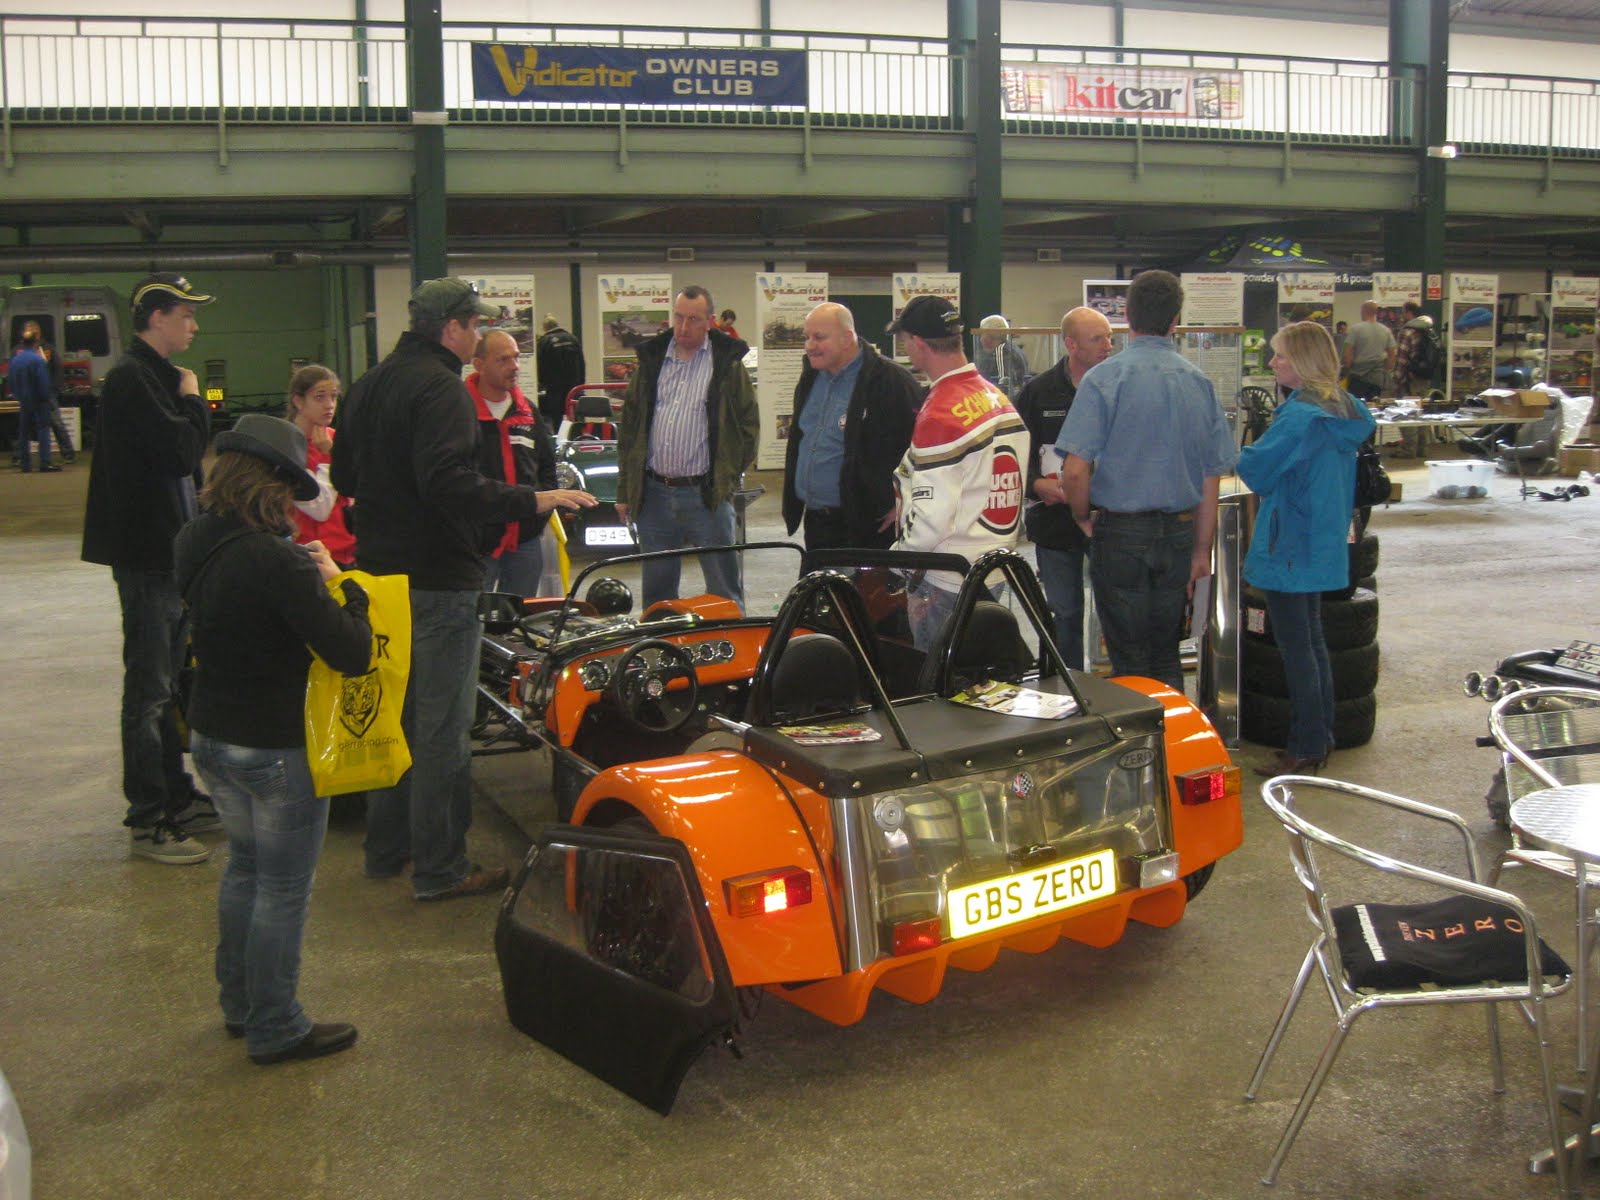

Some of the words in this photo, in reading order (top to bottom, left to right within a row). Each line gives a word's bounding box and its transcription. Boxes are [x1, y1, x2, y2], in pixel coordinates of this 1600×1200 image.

[489, 45, 638, 97] Vindicator
[645, 58, 780, 77] OWNERS
[672, 78, 754, 96] CLUB
[991, 472, 1020, 490] UCKY
[1124, 751, 1152, 767] ZERO
[964, 883, 1023, 925] GBS
[1033, 860, 1102, 908] ZERO
